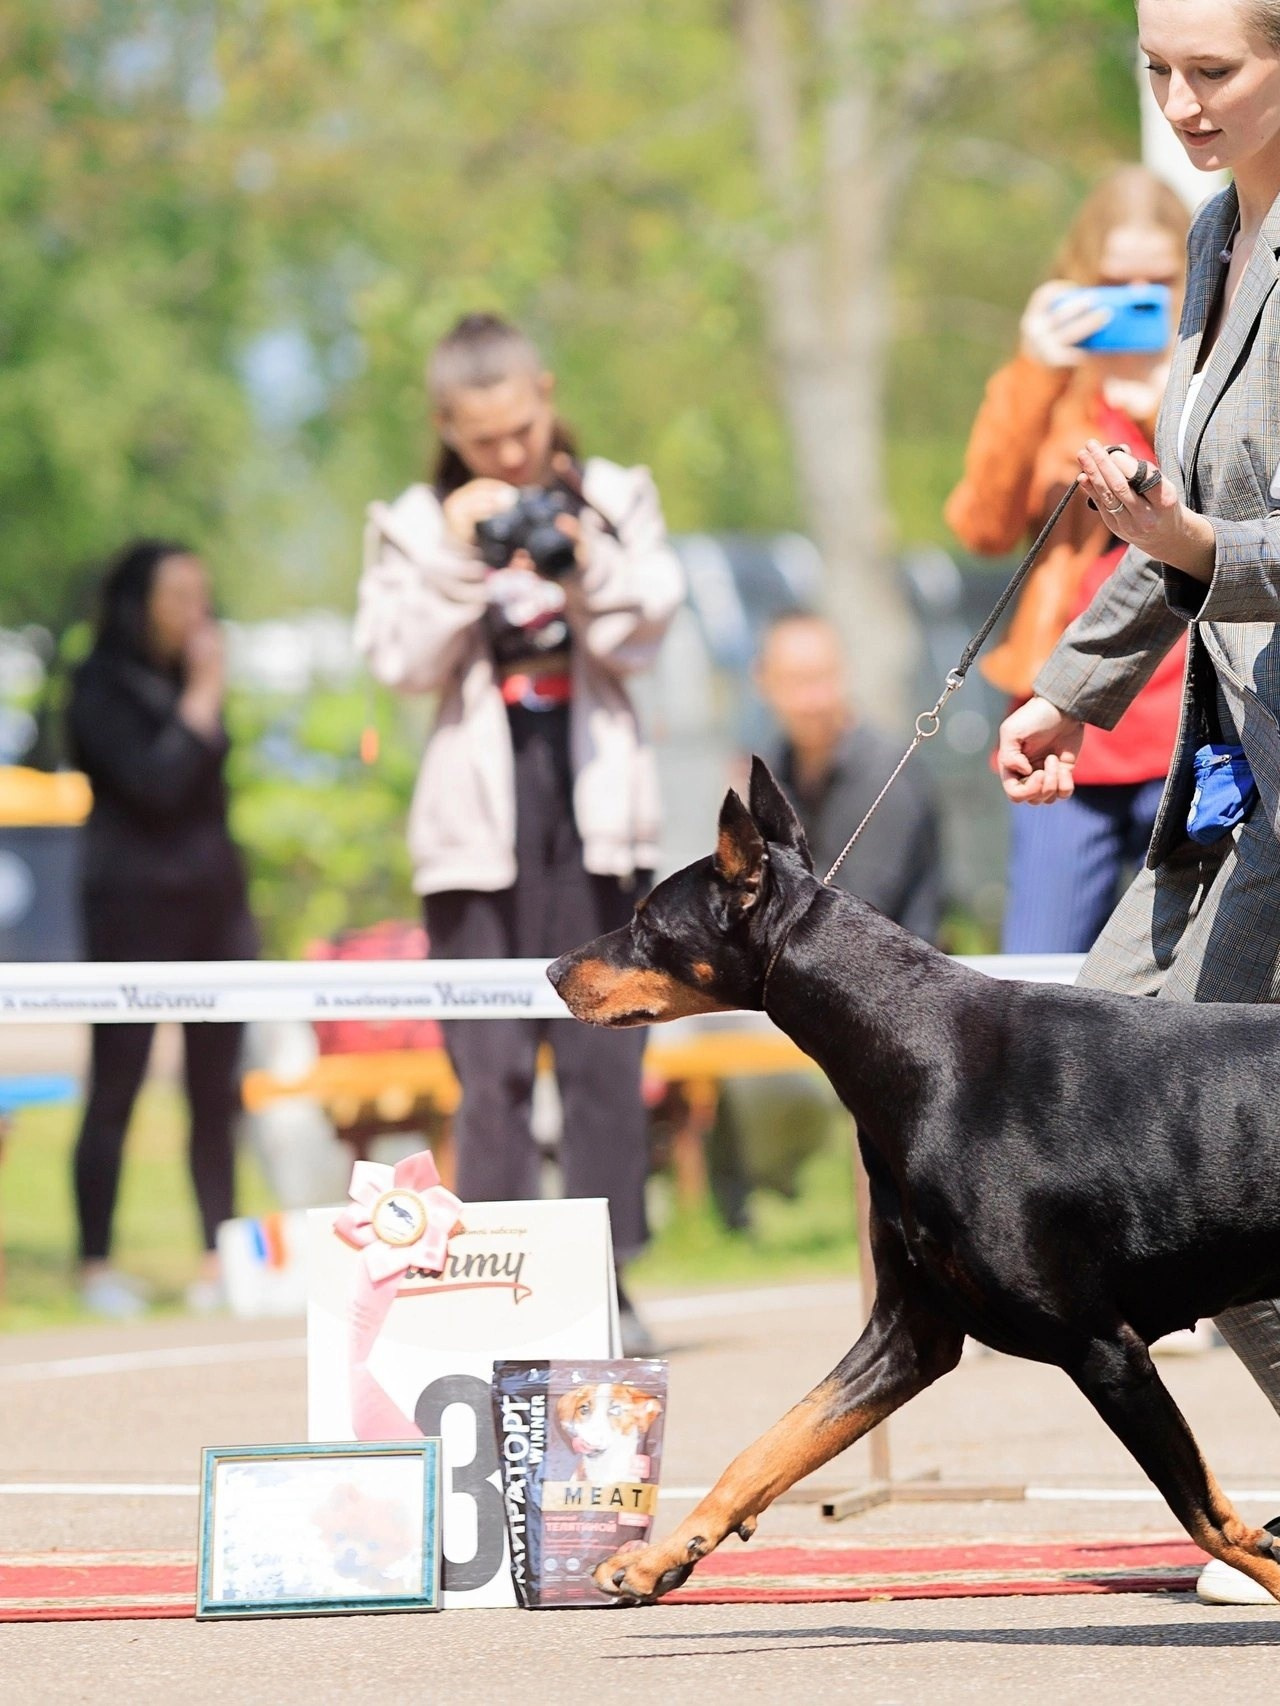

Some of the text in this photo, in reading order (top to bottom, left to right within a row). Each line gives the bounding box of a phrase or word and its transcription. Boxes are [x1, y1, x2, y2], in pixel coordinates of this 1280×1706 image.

[405, 1252, 525, 1305] rmy
[528, 1395, 546, 1465] WINNER
[414, 1374, 505, 1592] 3
[564, 1486, 643, 1508] MEAT
